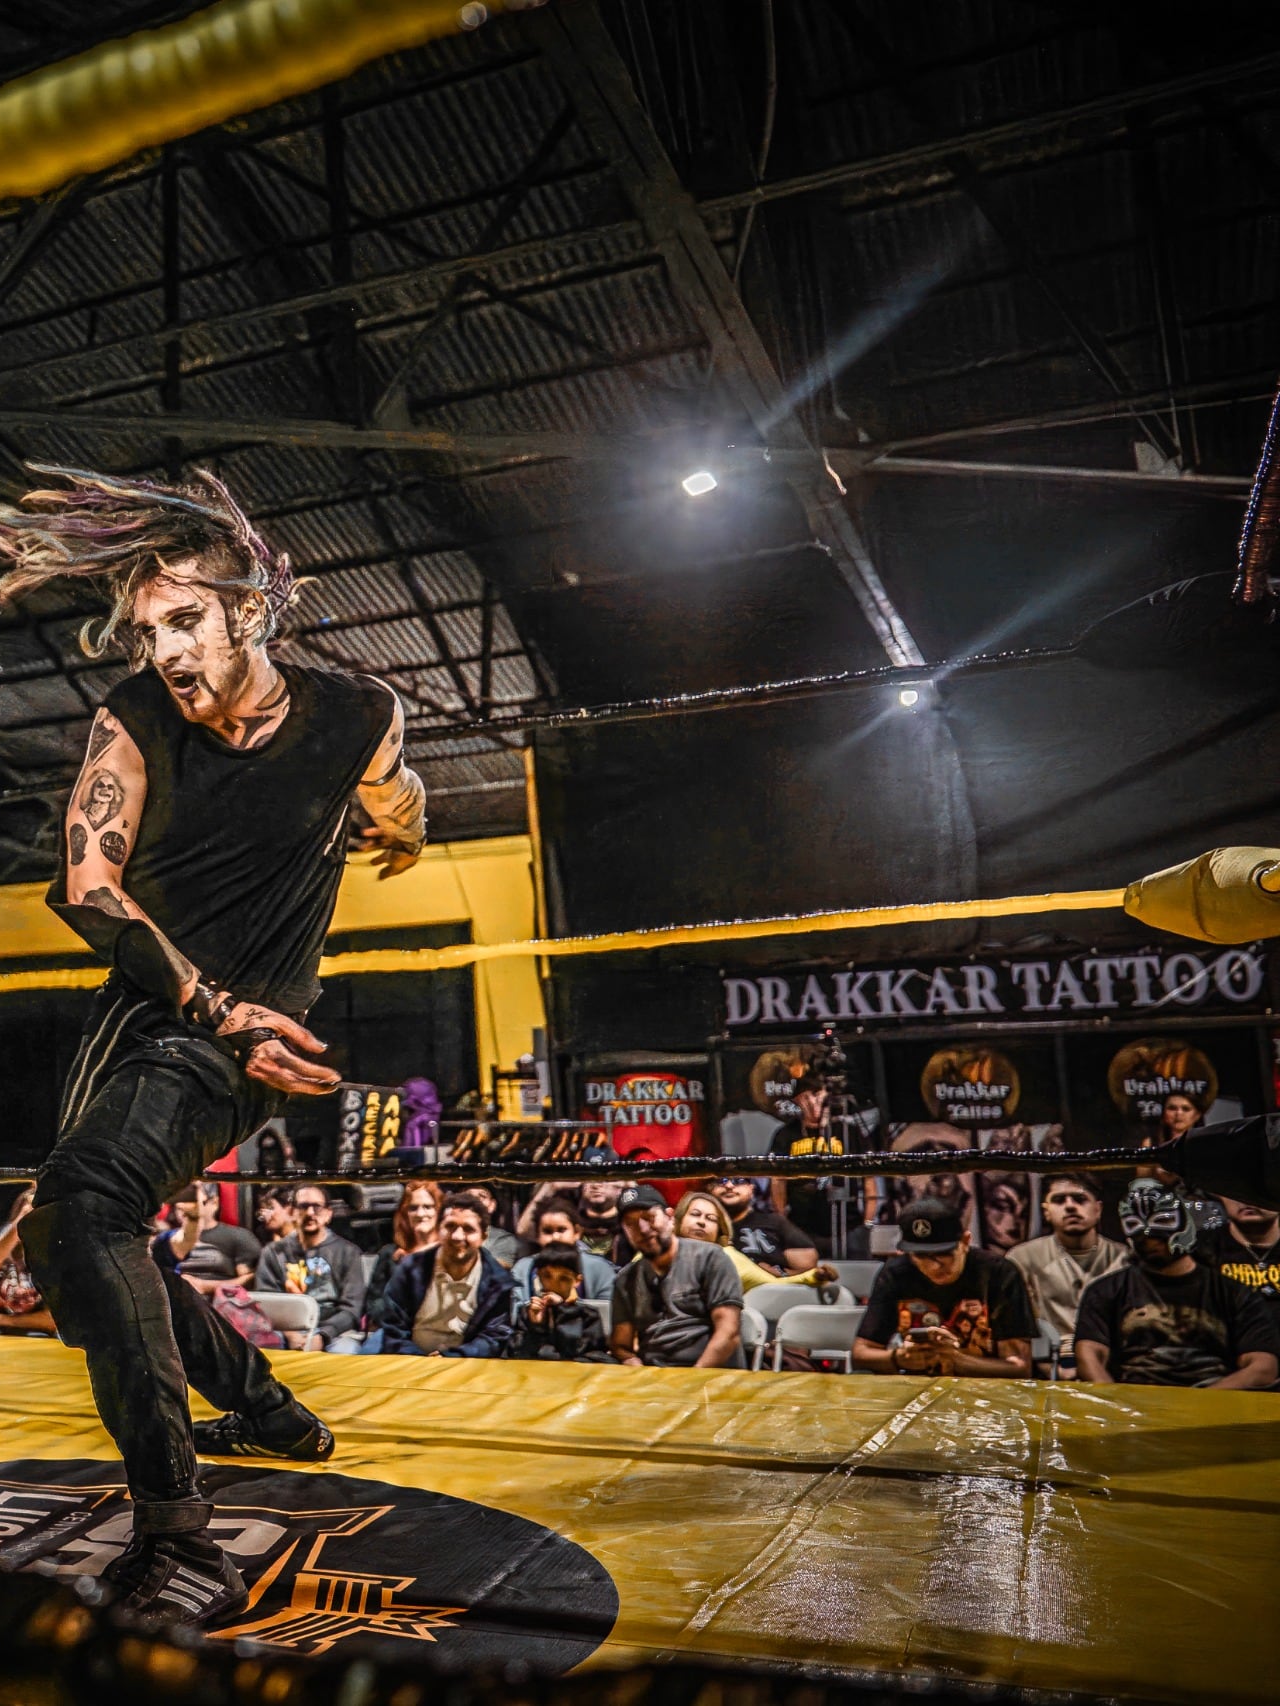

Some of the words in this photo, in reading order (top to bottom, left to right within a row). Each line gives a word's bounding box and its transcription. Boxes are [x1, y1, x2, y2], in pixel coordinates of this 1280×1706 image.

[722, 964, 1005, 1026] DRAKKAR
[1011, 949, 1265, 1013] TATTOO
[585, 1080, 705, 1103] DRAKKAR
[599, 1103, 692, 1125] TATTOO
